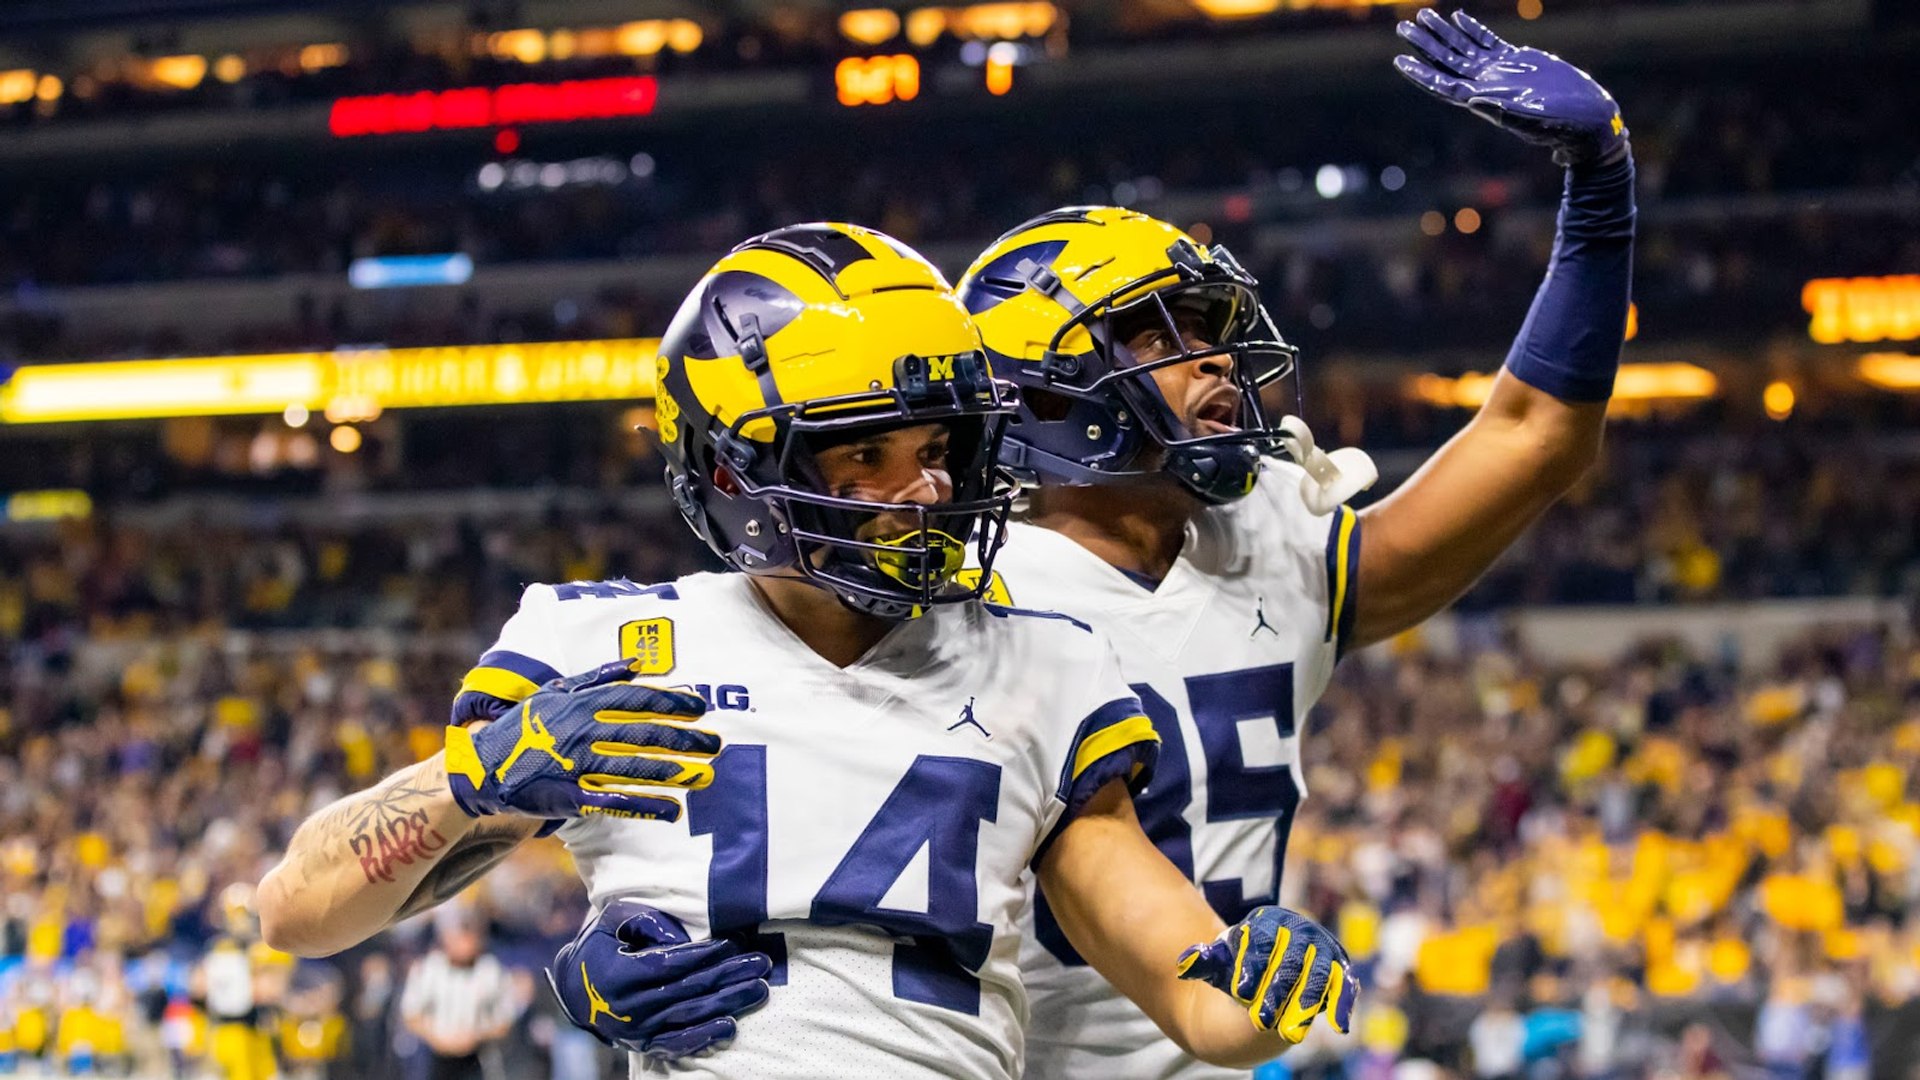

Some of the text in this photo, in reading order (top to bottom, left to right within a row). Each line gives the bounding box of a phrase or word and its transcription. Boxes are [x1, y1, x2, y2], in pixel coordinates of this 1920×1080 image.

[928, 356, 955, 381] M
[636, 624, 659, 635] TM
[636, 636, 659, 650] 42
[680, 684, 750, 711] 1G
[686, 744, 1002, 1017] 14
